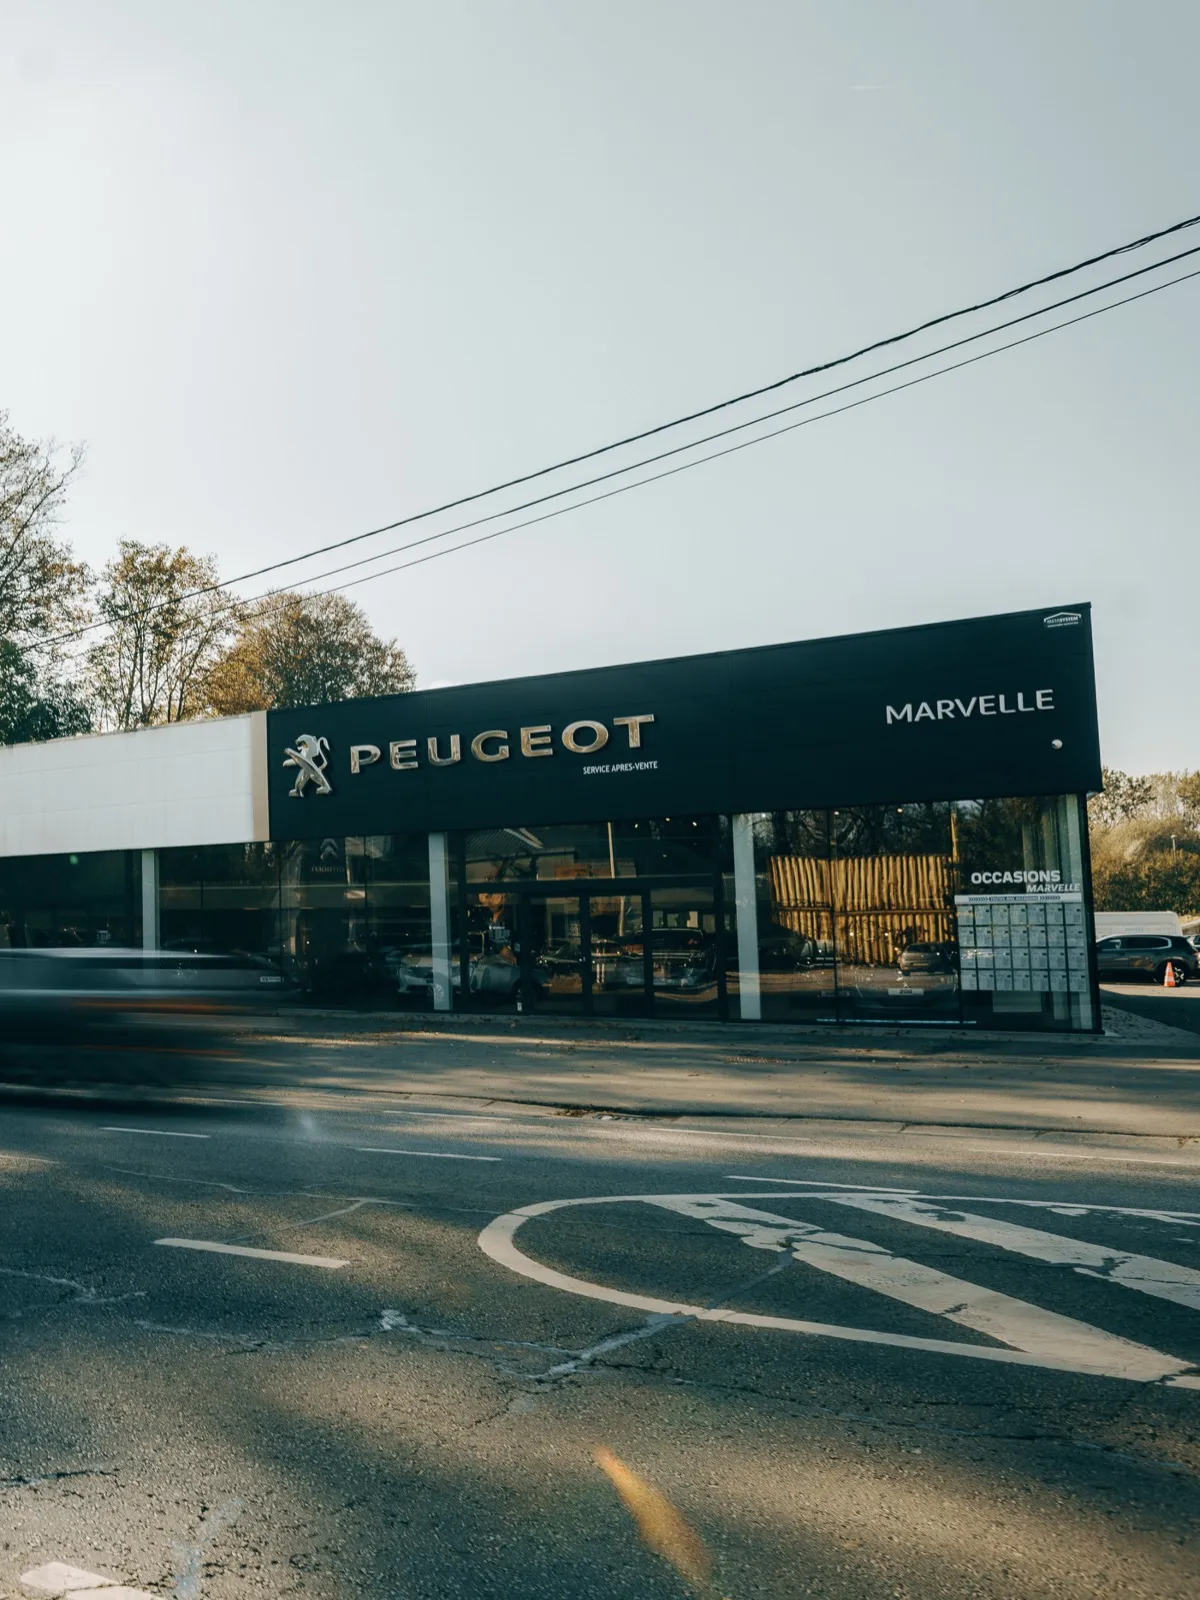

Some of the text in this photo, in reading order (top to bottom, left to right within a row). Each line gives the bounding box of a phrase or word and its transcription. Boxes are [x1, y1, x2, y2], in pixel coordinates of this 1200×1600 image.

[886, 689, 1055, 724] MARVELLE
[350, 714, 654, 774] PEUGEOT
[583, 761, 658, 775] SERVICE APRES-VENTE
[971, 870, 1061, 884] OCCASIONS
[1026, 883, 1081, 893] MARVELLE
